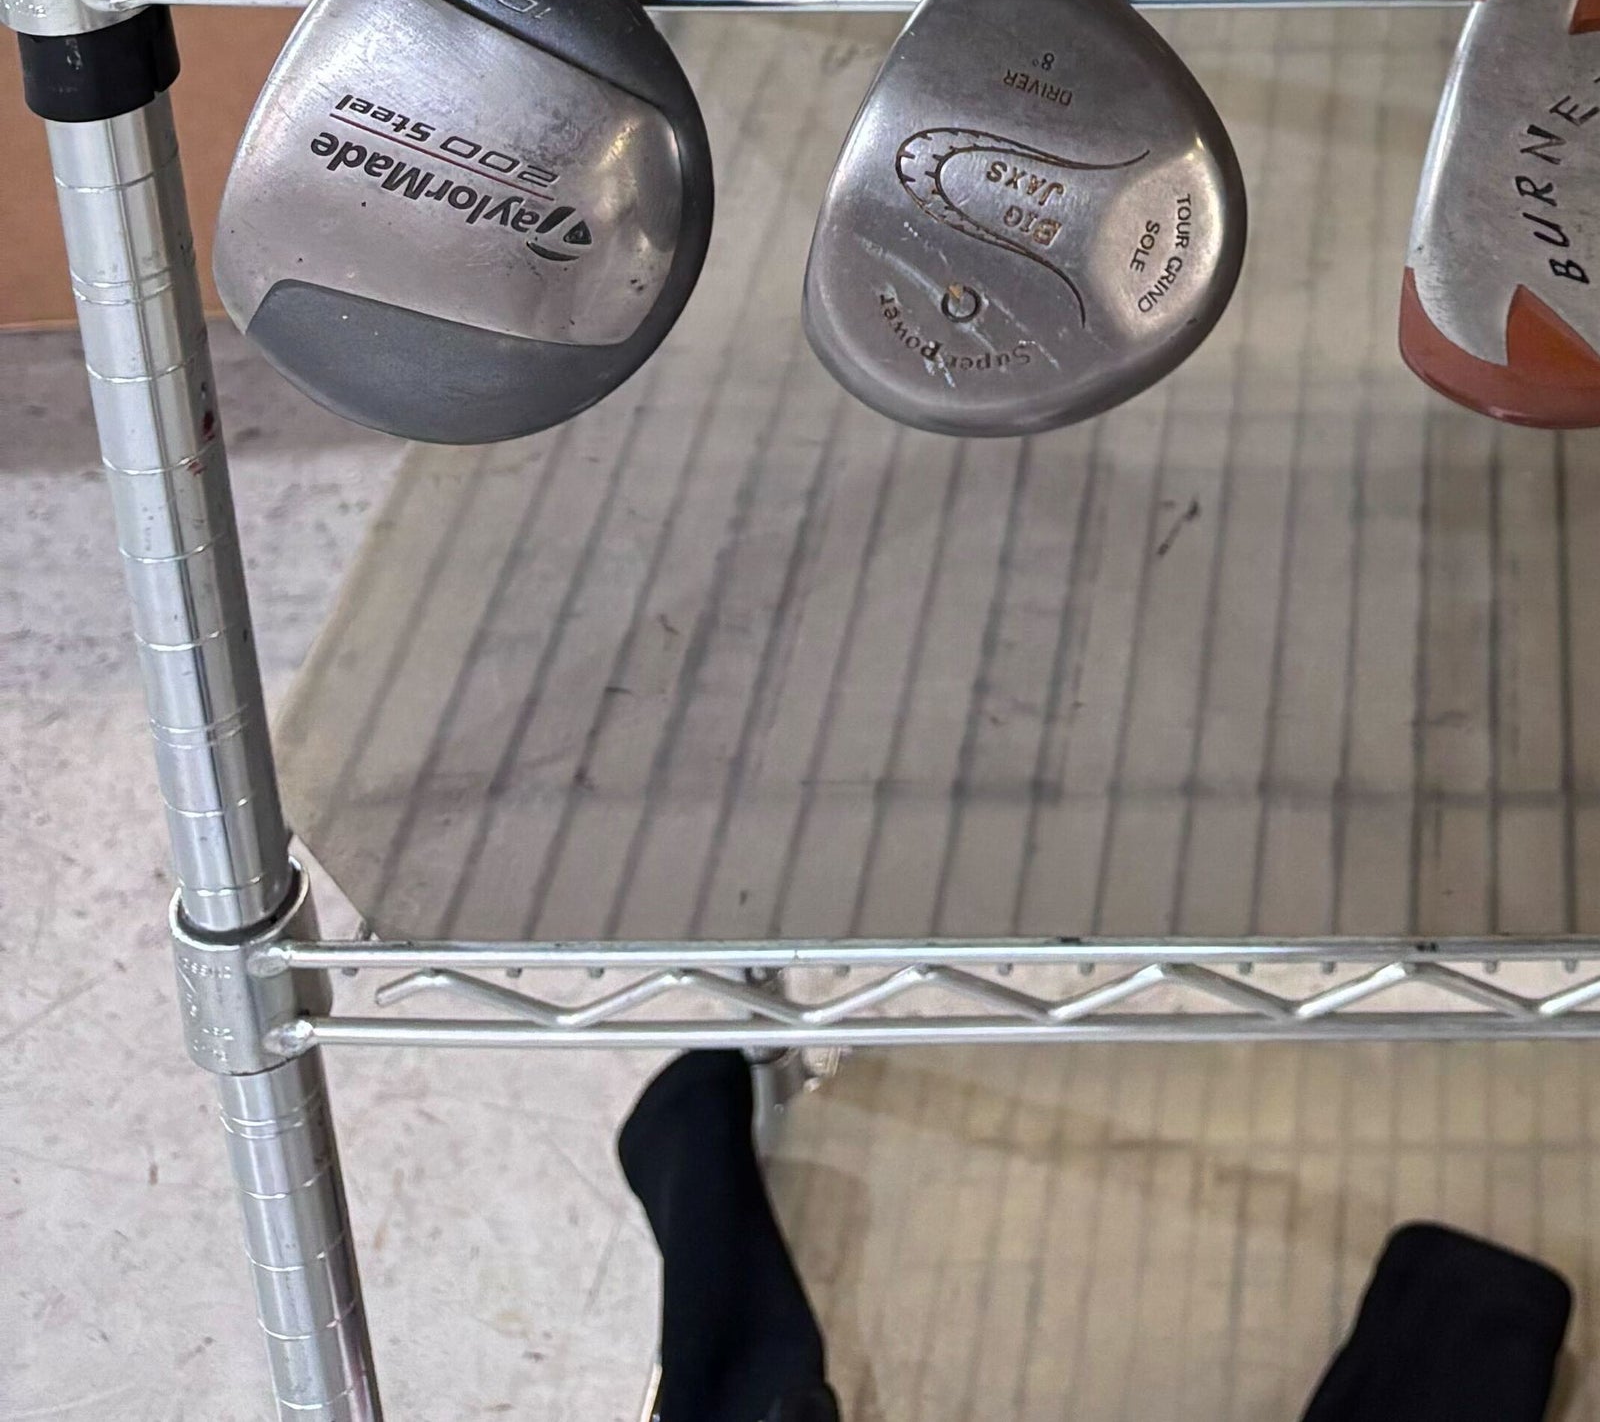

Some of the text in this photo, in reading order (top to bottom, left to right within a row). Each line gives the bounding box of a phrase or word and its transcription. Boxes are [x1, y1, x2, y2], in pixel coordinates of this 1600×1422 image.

[1002, 70, 1073, 107] DRIVER
[336, 95, 560, 188] 200 Steel
[310, 131, 591, 261] TaylorMade
[986, 160, 1064, 206] JAXS
[1130, 220, 1161, 273] SOLE
[1138, 193, 1192, 313] TOUR GRIND
